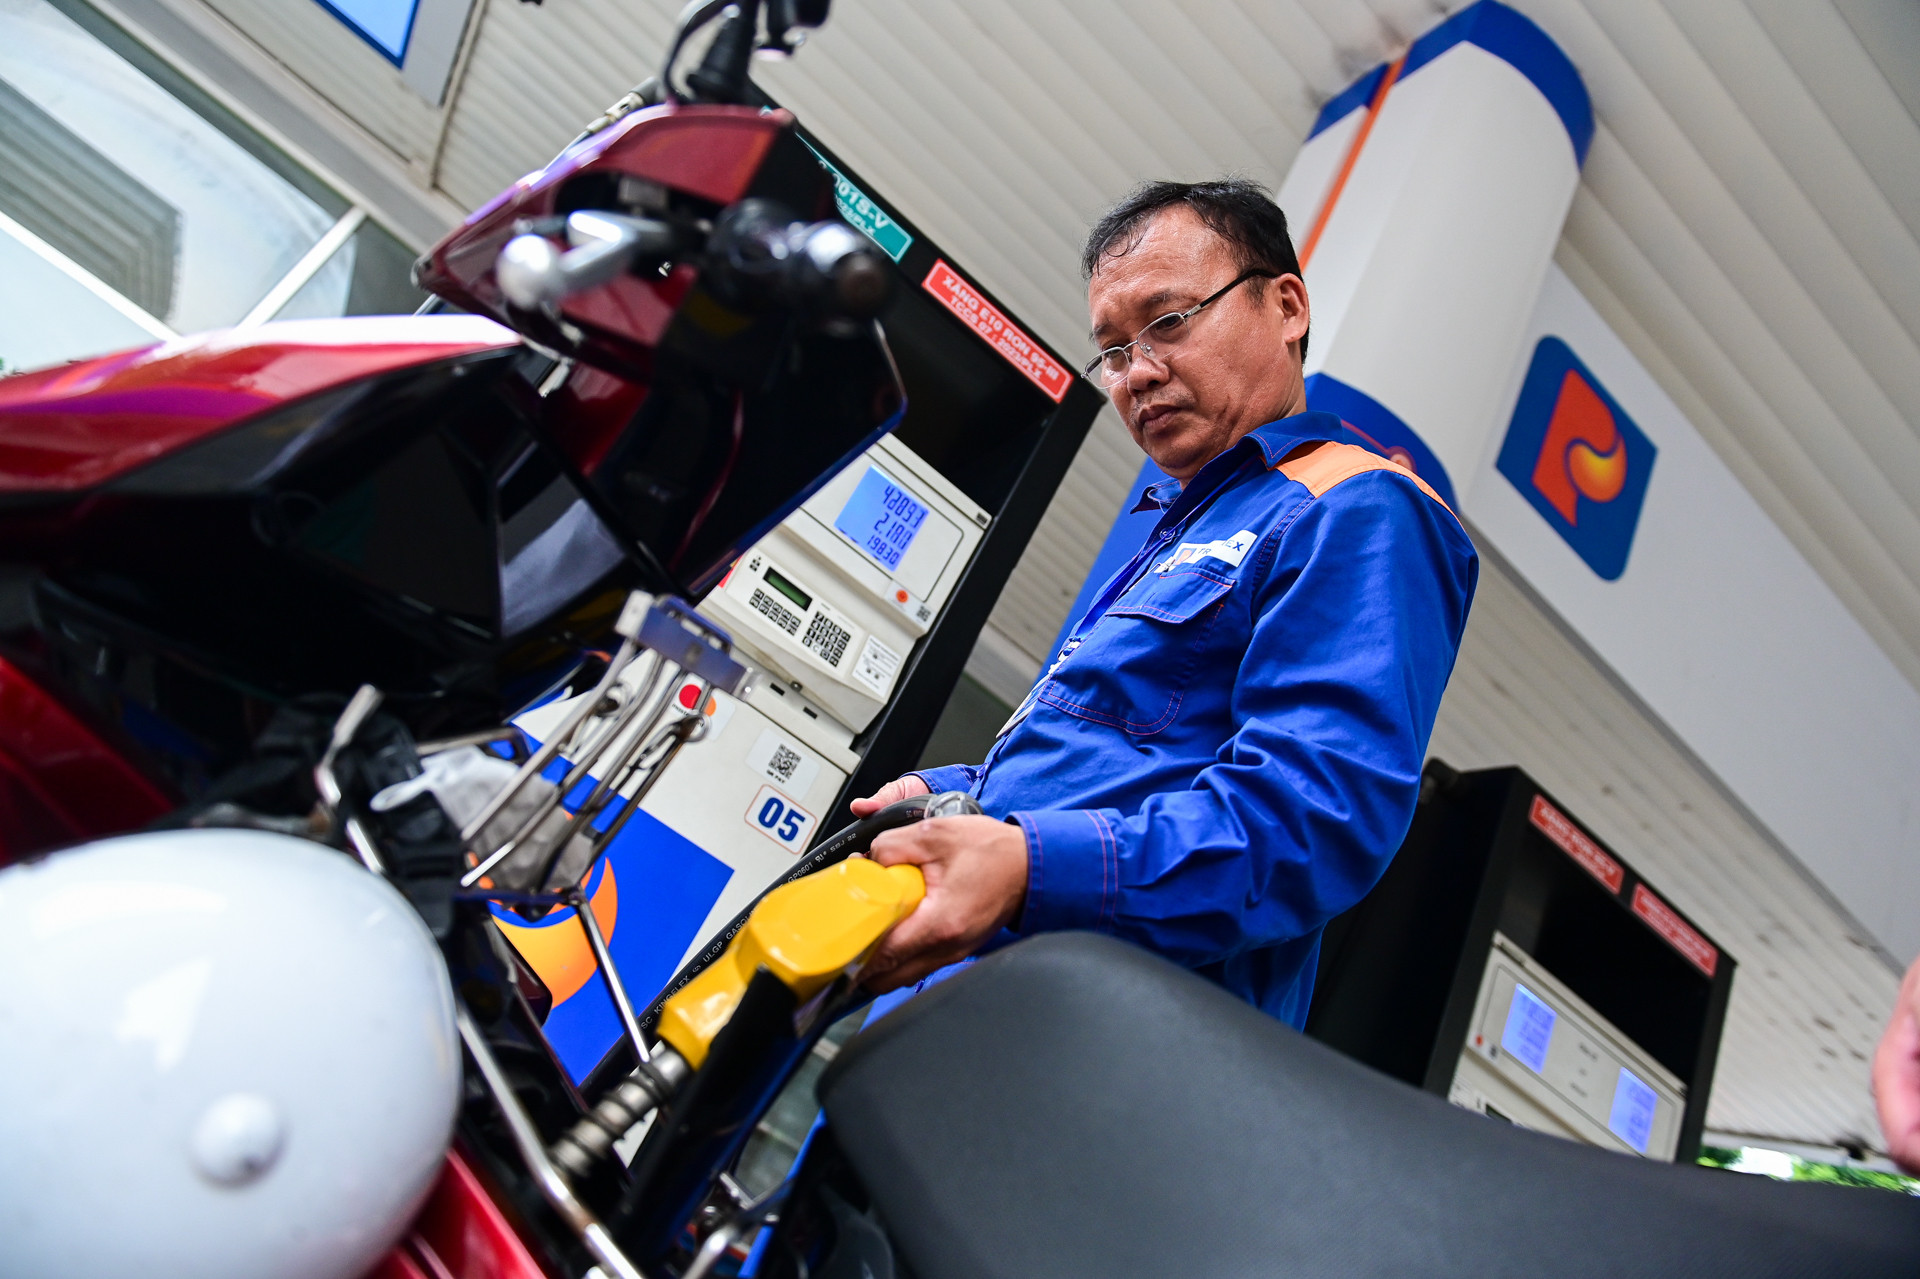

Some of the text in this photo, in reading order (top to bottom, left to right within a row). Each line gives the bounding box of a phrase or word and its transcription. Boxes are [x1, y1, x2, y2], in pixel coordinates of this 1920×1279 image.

[950, 296, 979, 324] TCCS
[978, 307, 1003, 332] E10
[1003, 327, 1031, 356] RON
[866, 534, 900, 565] 19830
[758, 796, 806, 842] 05
[702, 941, 723, 963] ULGP
